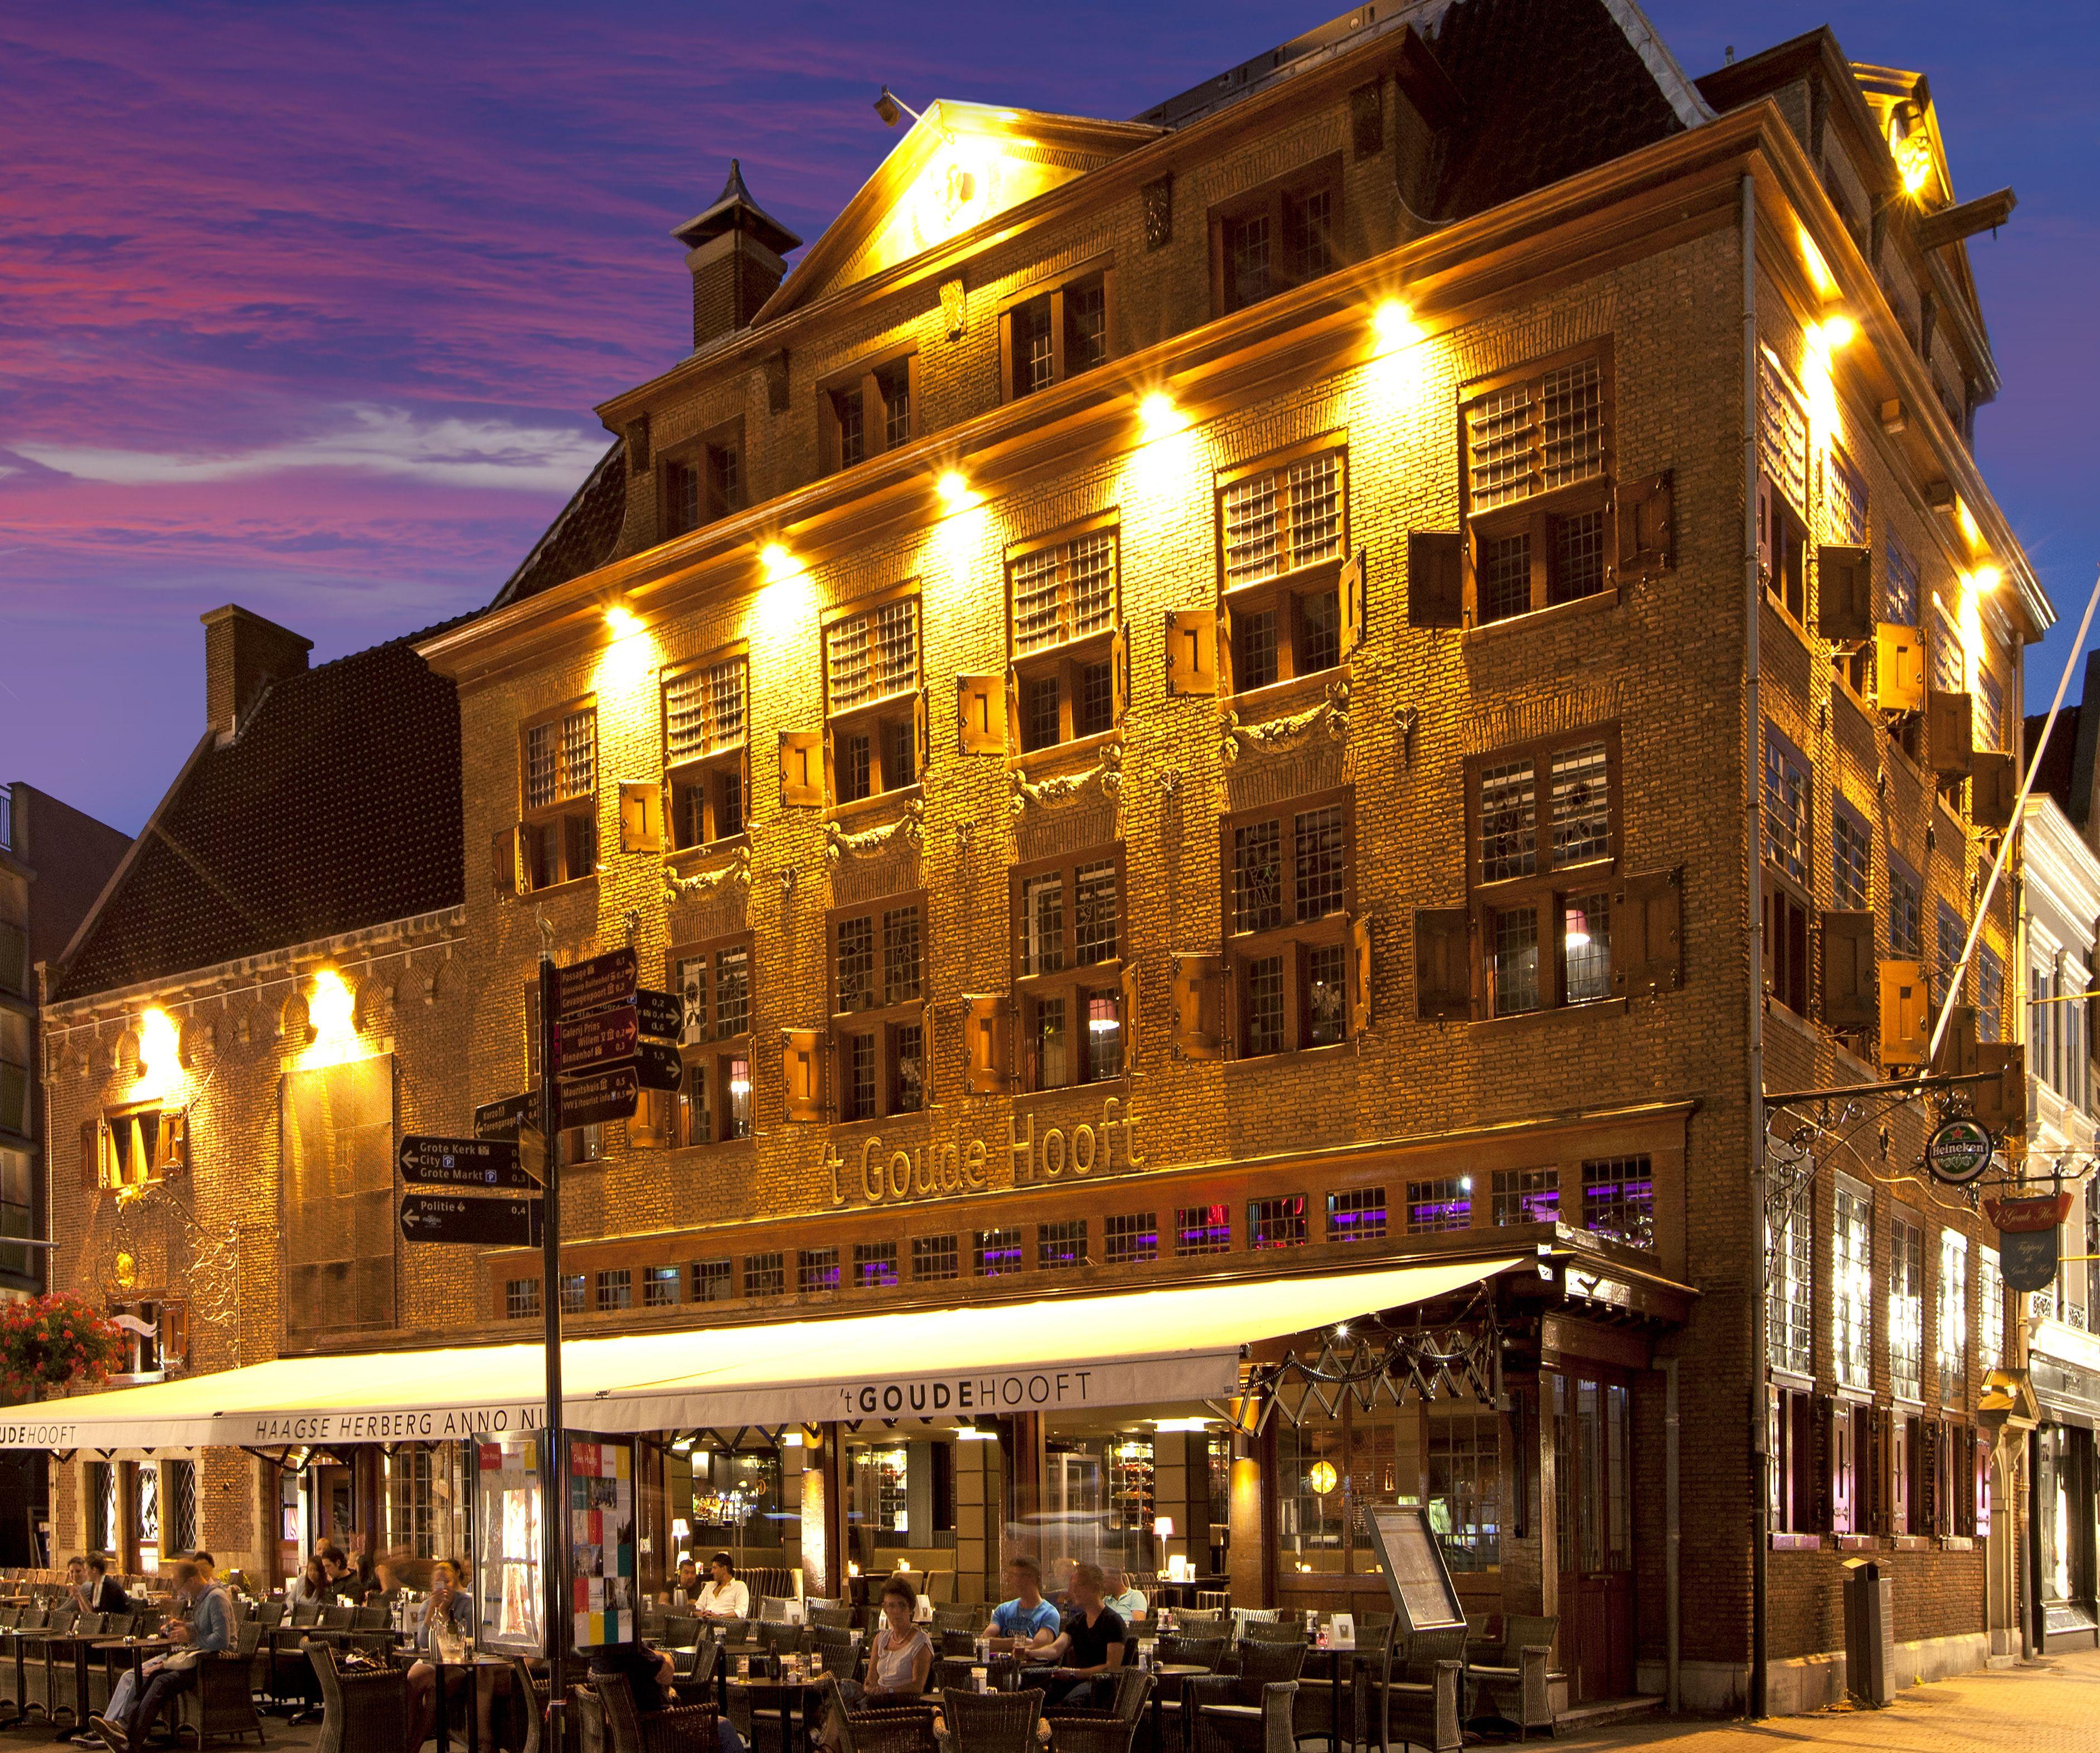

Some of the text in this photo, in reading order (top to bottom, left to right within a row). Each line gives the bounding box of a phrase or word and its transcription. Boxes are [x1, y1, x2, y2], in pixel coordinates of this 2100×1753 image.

[562, 970, 586, 982] Passage
[562, 988, 606, 1008] Gevangenpoort
[652, 1010, 664, 1019] 0,4
[562, 1021, 600, 1039] Galerij Prins
[578, 1034, 599, 1047] Willem
[562, 1049, 594, 1064] Binnenhof
[654, 1051, 665, 1060] 1,5
[563, 1082, 599, 1098] Mauritshuis
[483, 1110, 497, 1121] Korzo
[483, 1116, 516, 1132] Torengarage
[420, 1142, 449, 1154] Grote
[453, 1144, 476, 1155] Kerk
[818, 1097, 1145, 1205] 't Goude Hooft
[1932, 1142, 1984, 1156] Heineken
[420, 1155, 440, 1167] City
[420, 1168, 449, 1178] Grote
[453, 1170, 483, 1180] Markt
[421, 1200, 526, 1215] Politie 0,4
[255, 1418, 330, 1440] HAAGSE
[339, 1413, 431, 1437] HERBERG
[444, 1410, 507, 1434] ANNO
[574, 1453, 584, 1464] Den
[584, 1454, 598, 1466] Haag
